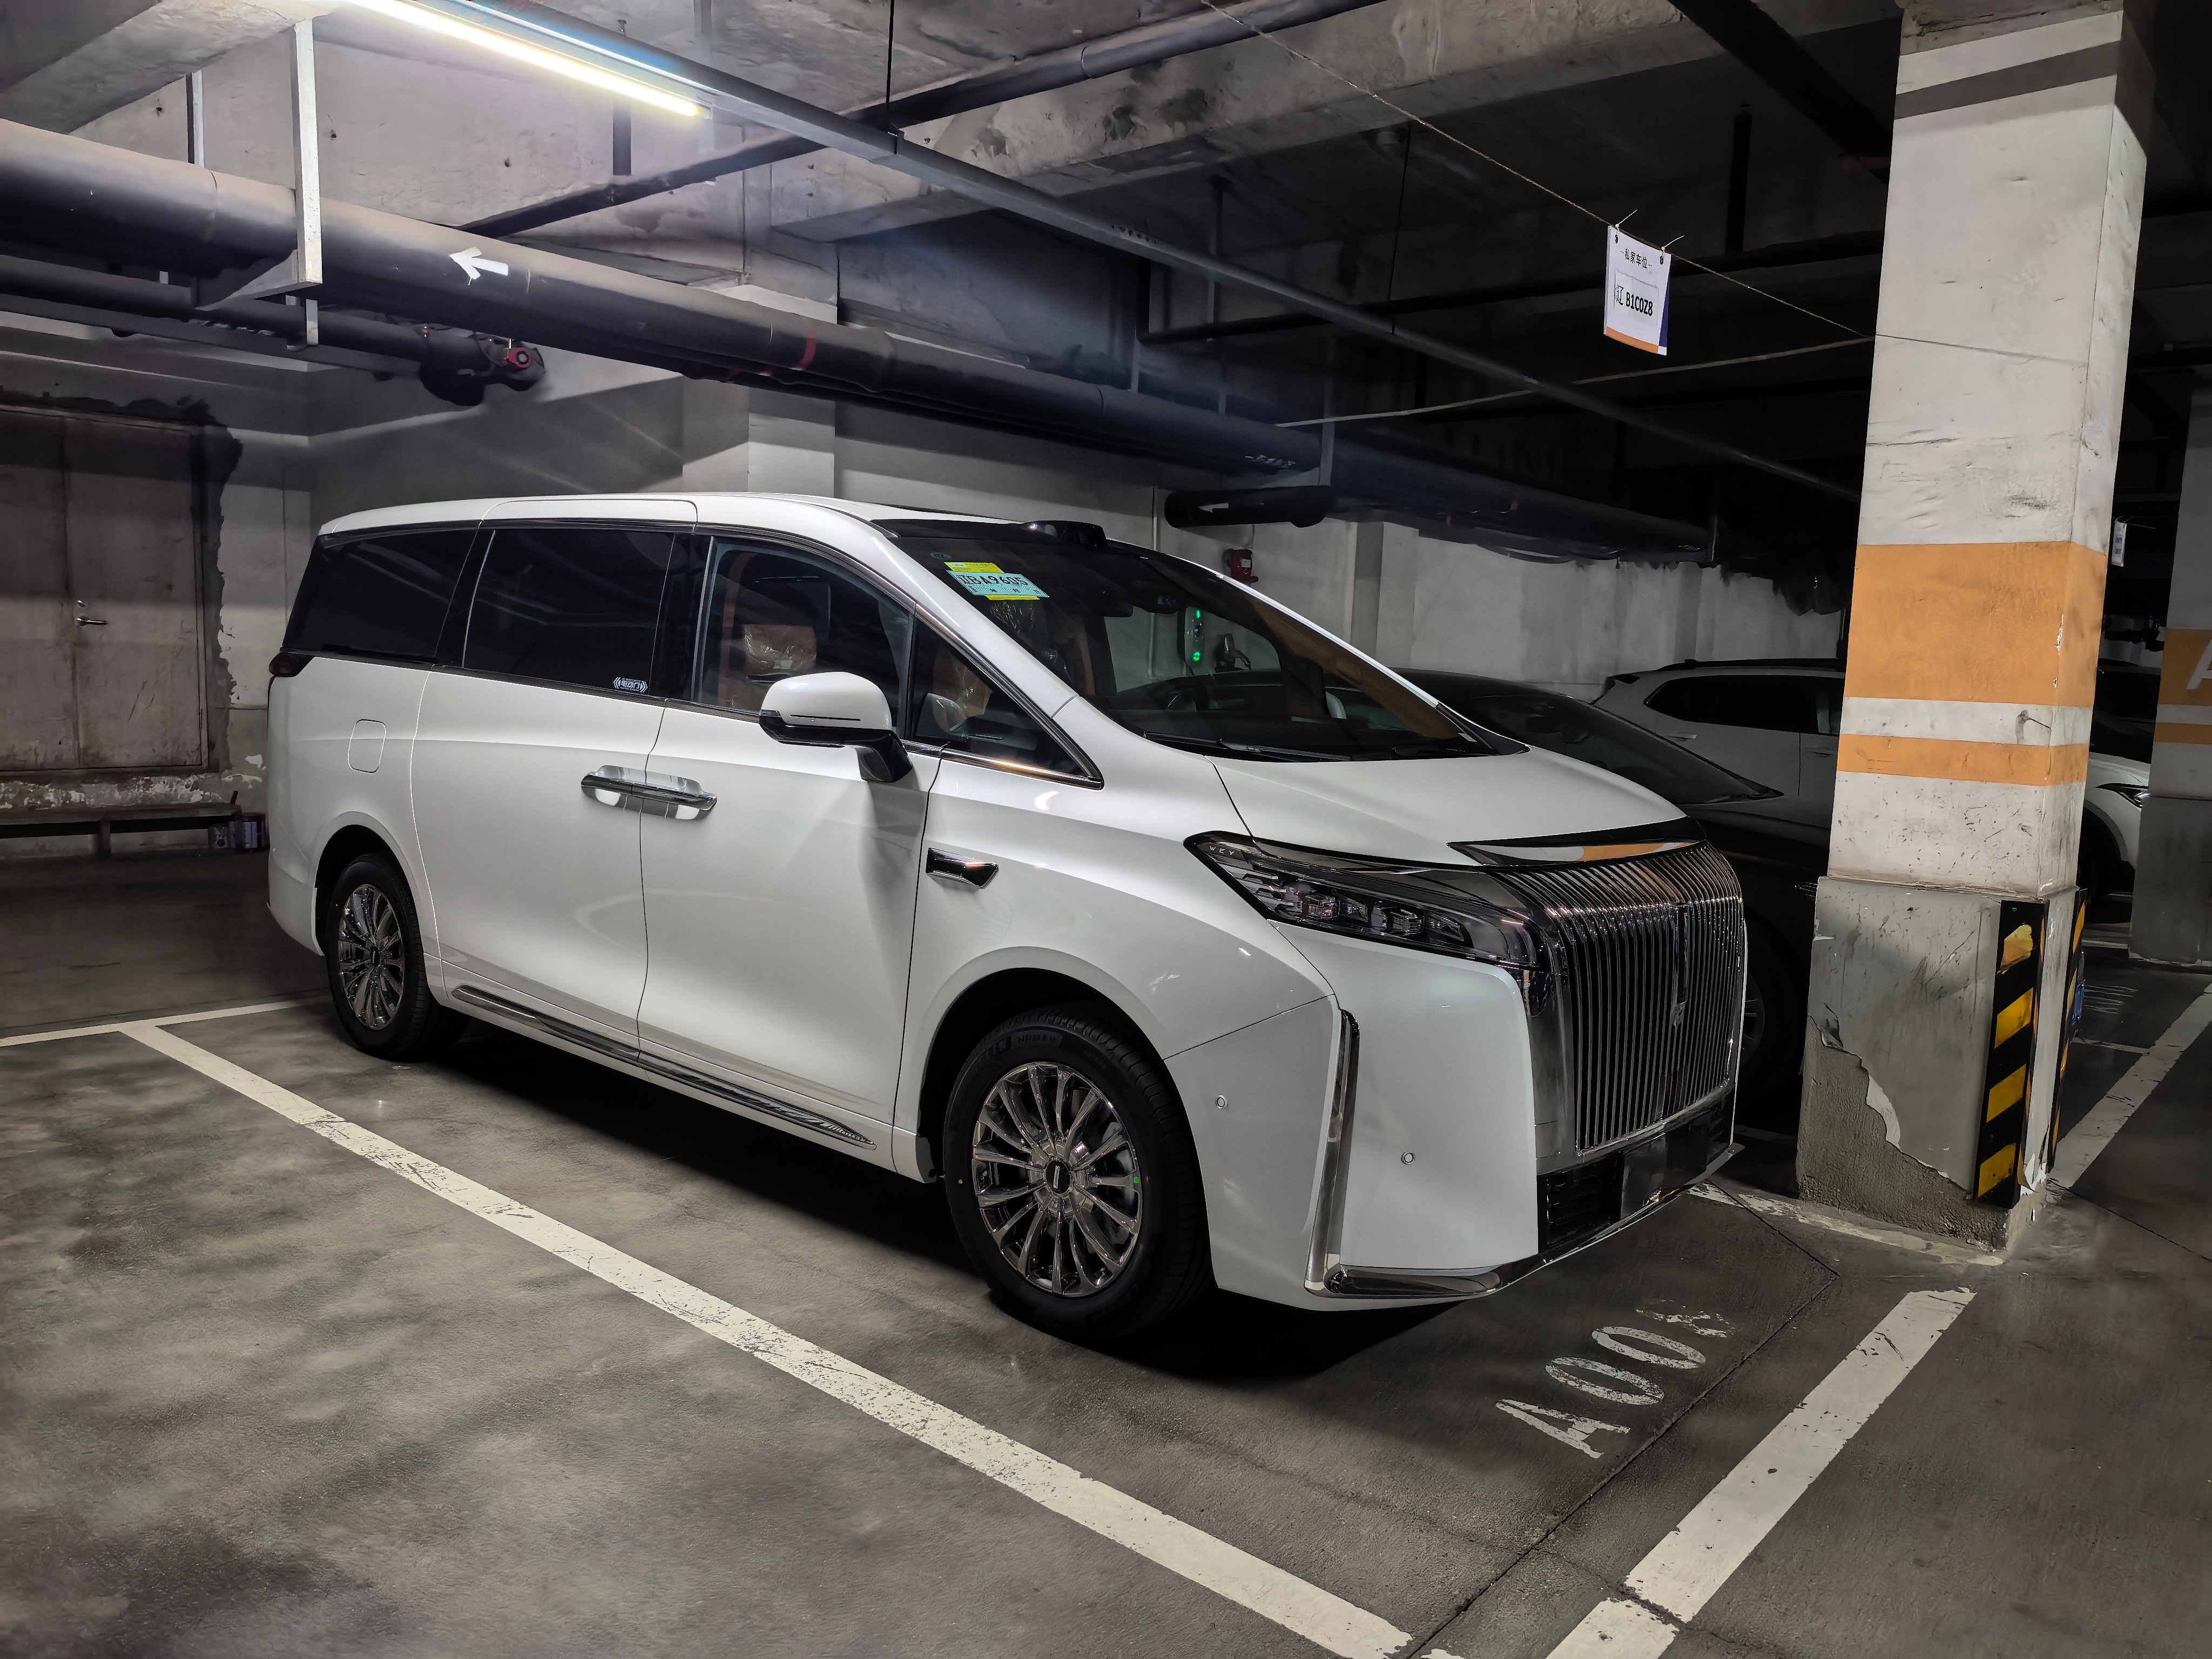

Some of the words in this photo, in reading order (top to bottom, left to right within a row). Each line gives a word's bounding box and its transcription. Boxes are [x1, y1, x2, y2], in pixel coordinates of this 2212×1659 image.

[1625, 248, 1648, 269] 私家车位
[956, 574, 1028, 585] 辽BA9605
[1210, 845, 1235, 855] WEY
